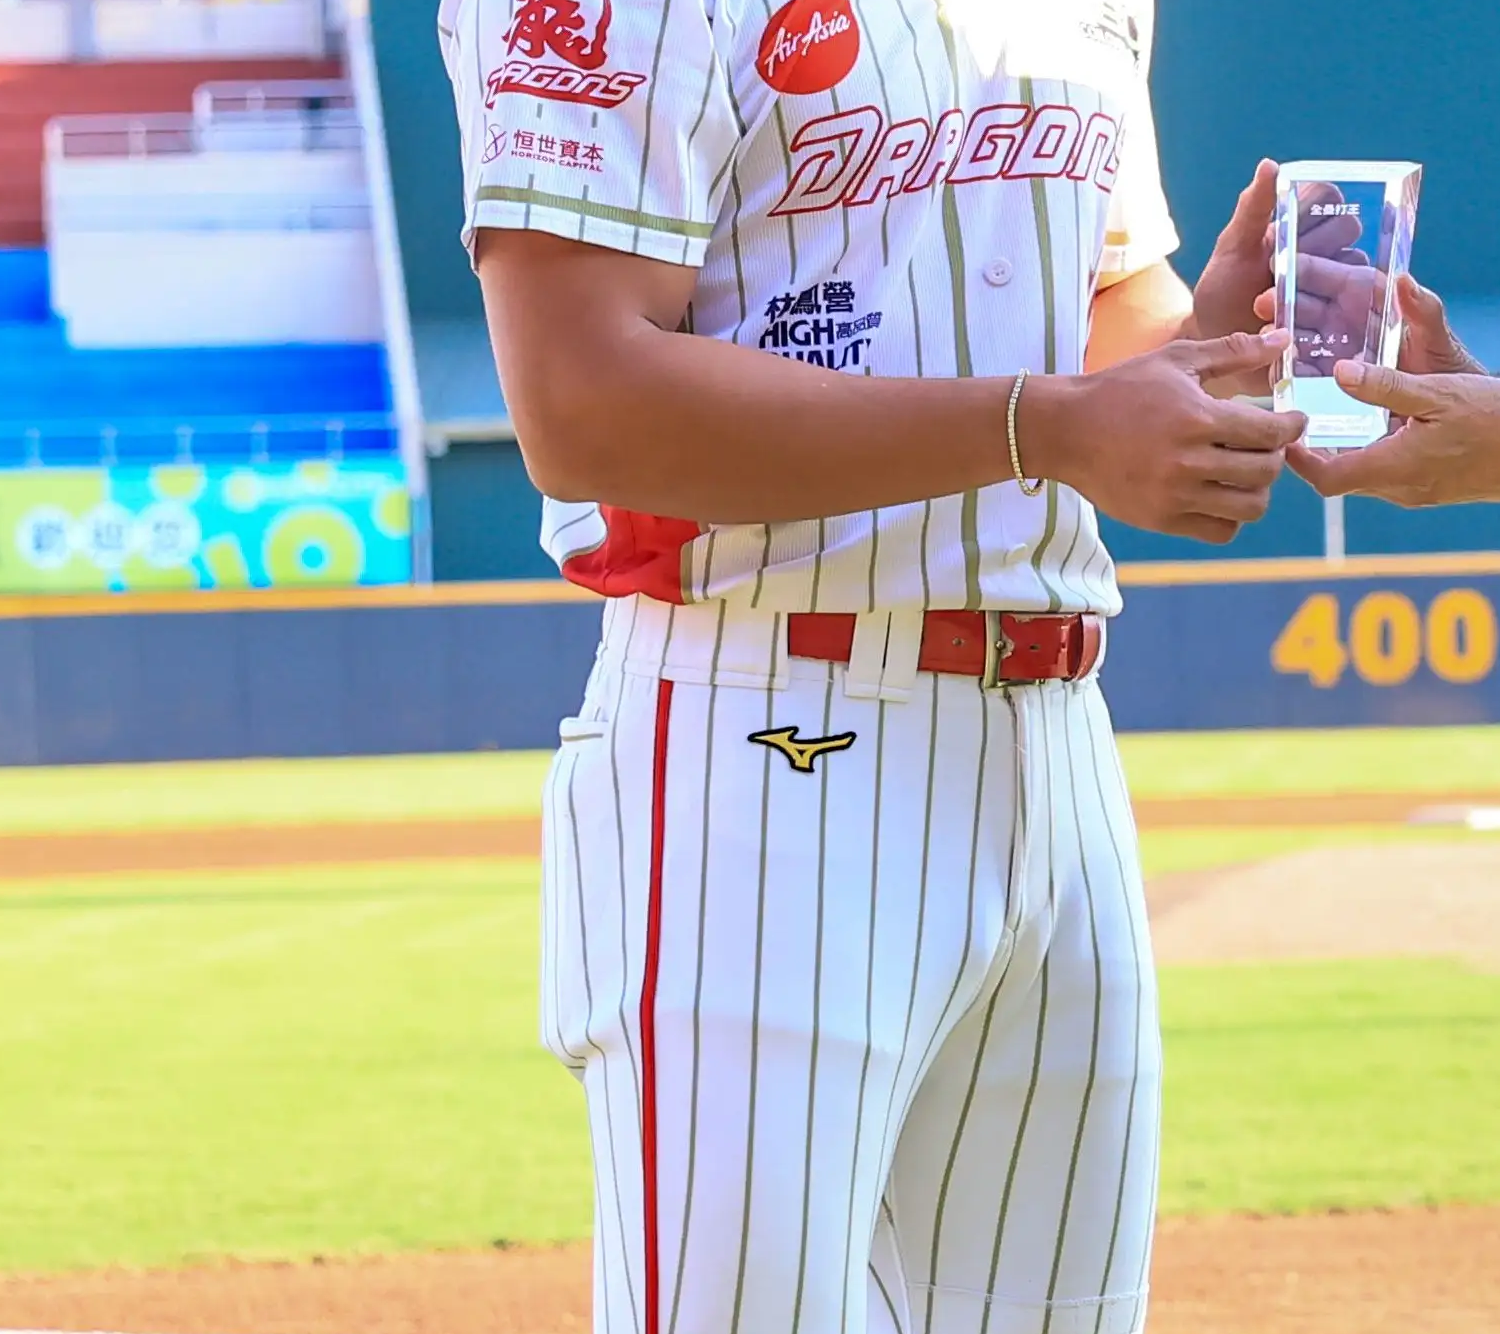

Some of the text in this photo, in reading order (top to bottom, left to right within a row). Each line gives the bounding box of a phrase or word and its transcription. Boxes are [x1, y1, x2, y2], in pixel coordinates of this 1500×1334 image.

[511, 150, 604, 173] HORIZON CAPITAL
[759, 318, 835, 350] HIGH
[1270, 587, 1499, 689] 400
